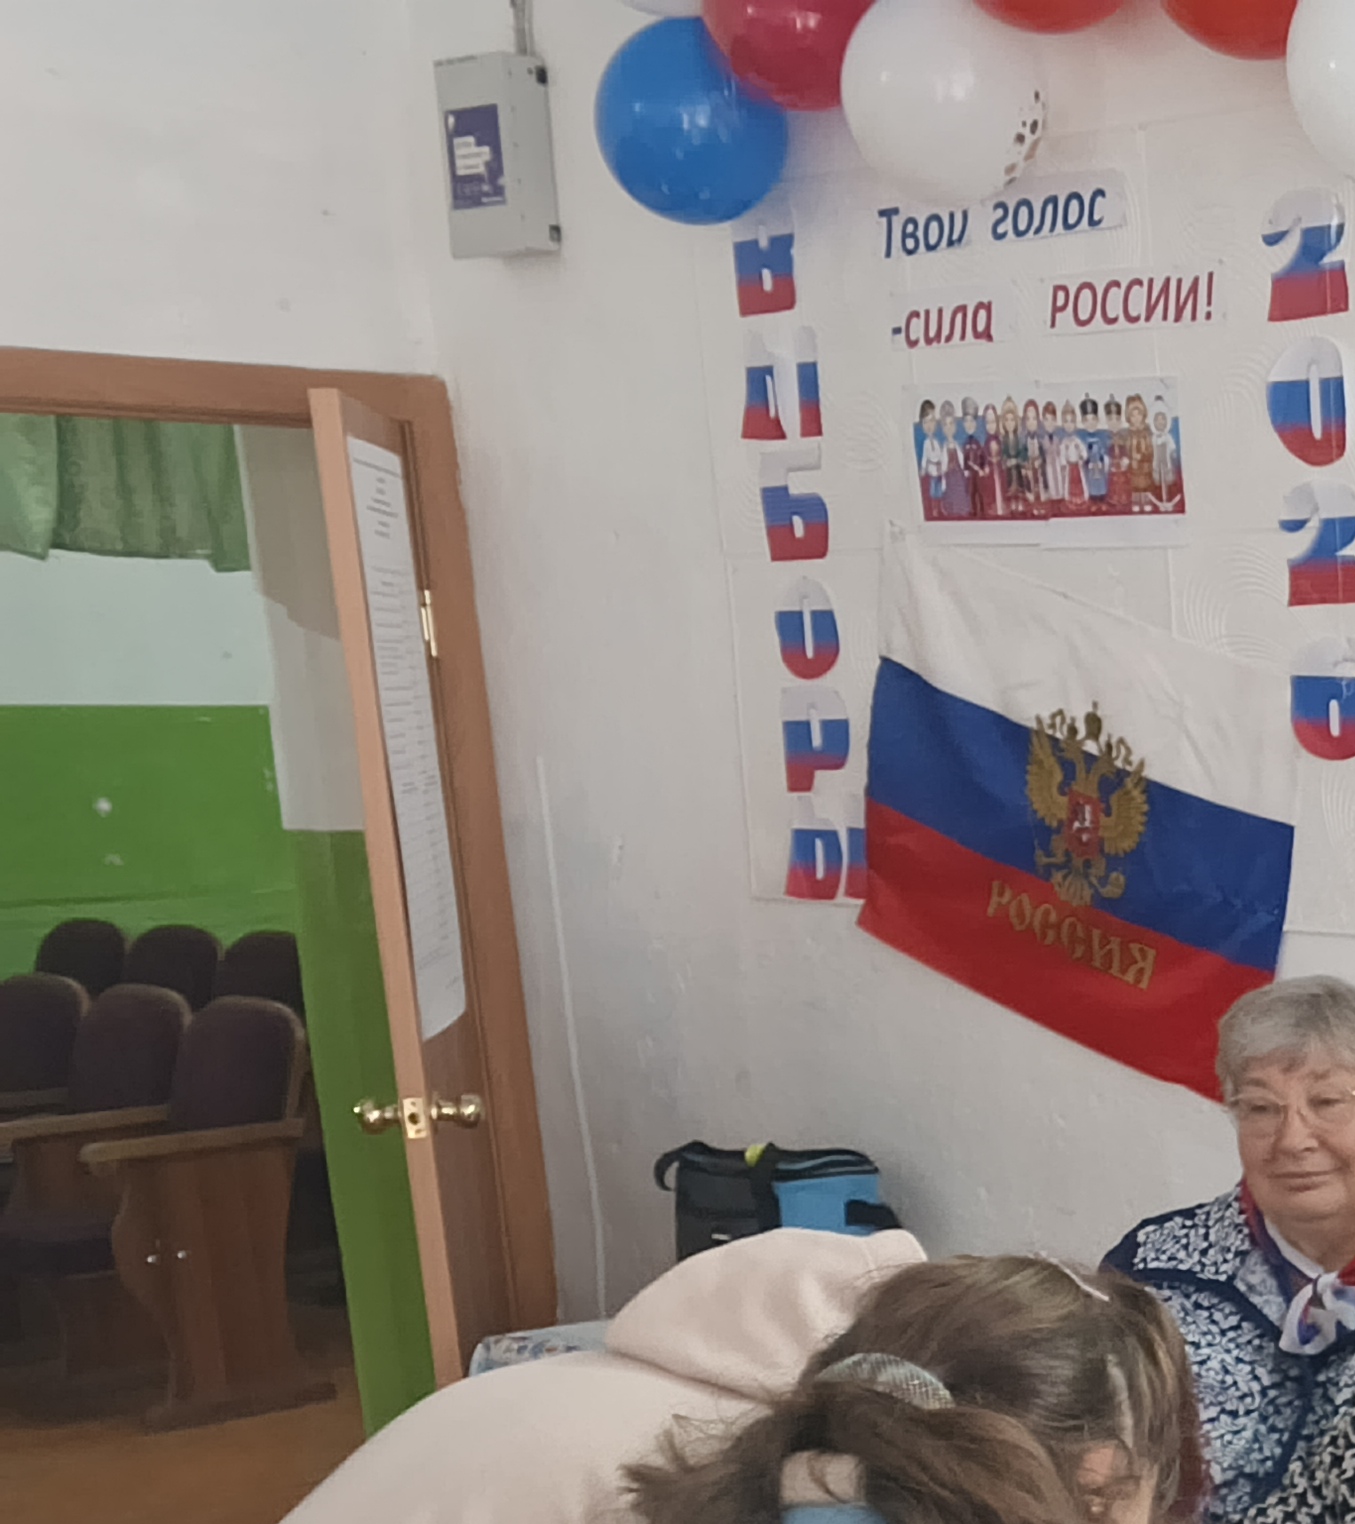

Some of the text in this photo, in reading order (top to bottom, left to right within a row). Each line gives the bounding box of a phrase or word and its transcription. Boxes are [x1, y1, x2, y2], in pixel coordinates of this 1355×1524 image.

[991, 187, 1107, 241] голос
[1050, 271, 1215, 328] РОССИИ!
[986, 881, 1157, 990] РОССИЯ
